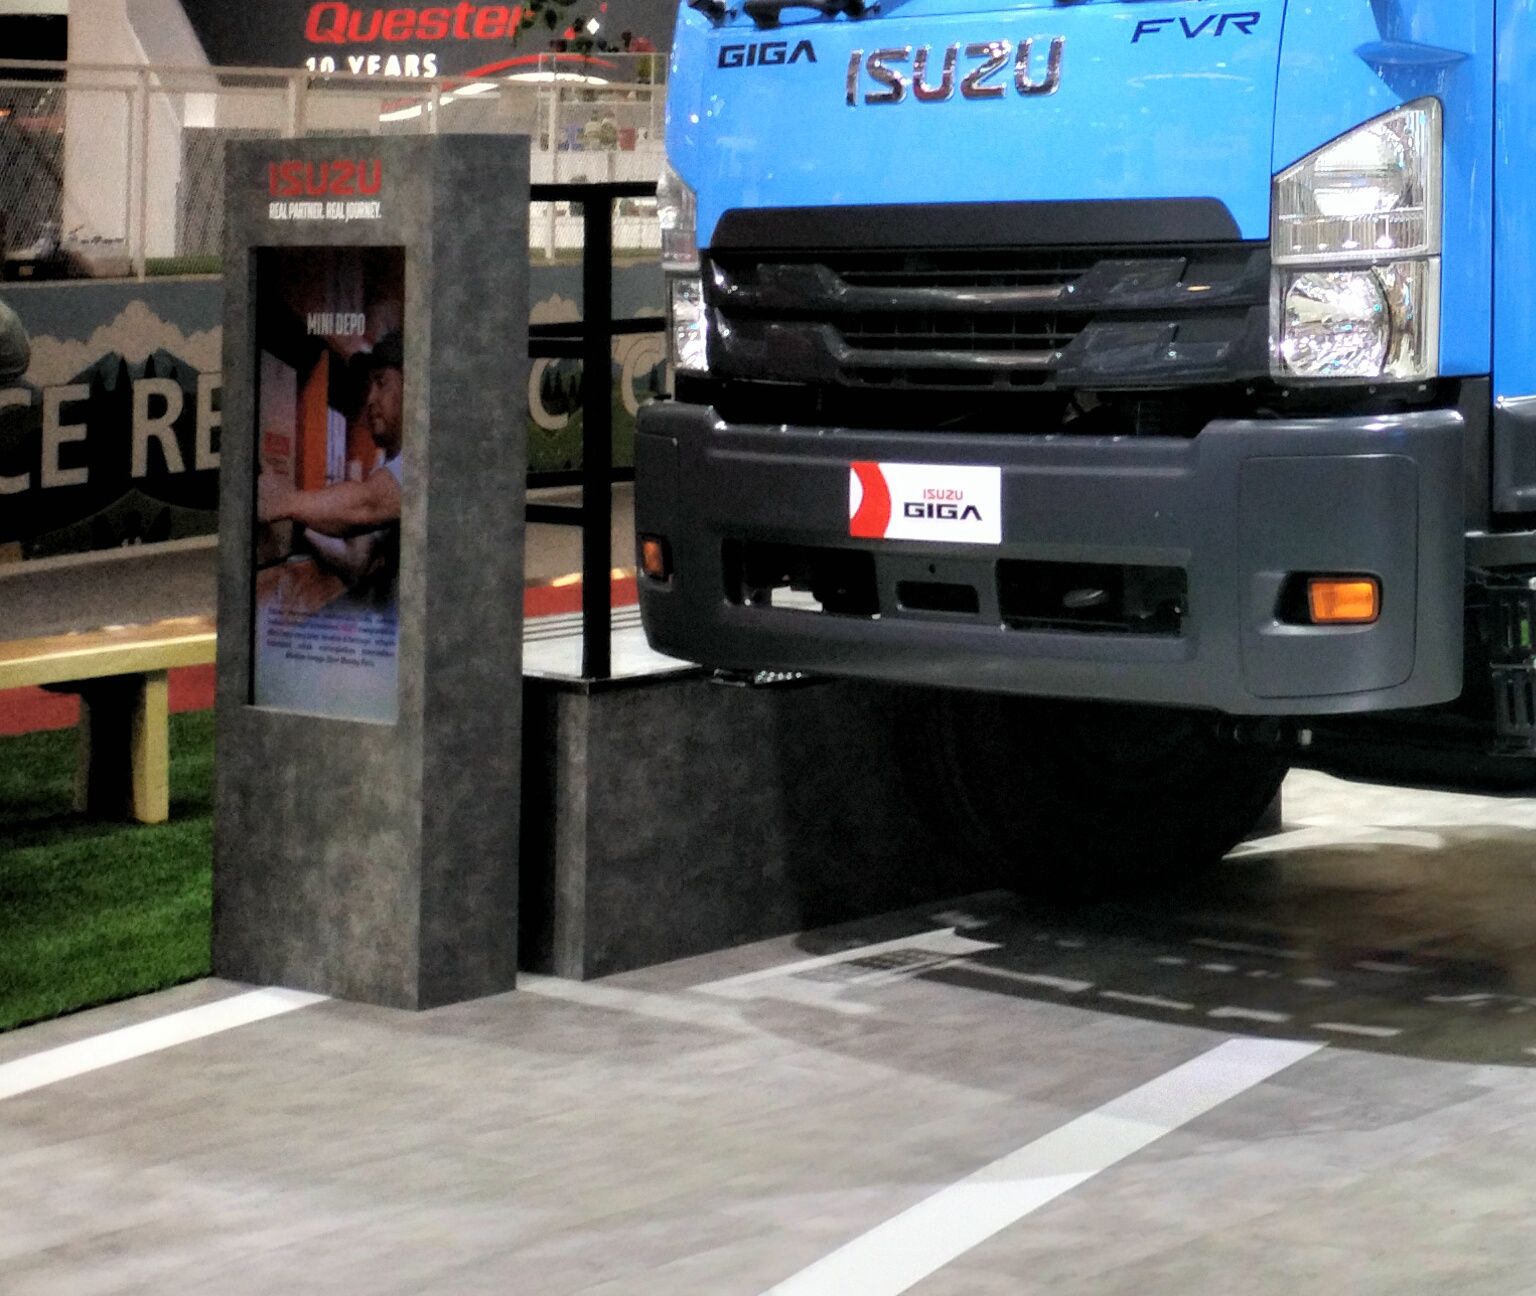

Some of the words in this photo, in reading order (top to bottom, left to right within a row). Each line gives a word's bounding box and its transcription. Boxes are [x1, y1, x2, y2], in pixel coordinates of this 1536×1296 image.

[304, 0, 534, 44] Quester
[1130, 11, 1261, 44] FVR
[306, 55, 334, 75] 10
[348, 53, 437, 78] YEARS
[717, 40, 818, 70] GIGA
[846, 35, 1066, 107] ISUZU
[269, 159, 382, 196] ISUZU
[269, 202, 288, 220] REAL
[326, 202, 345, 220] REAL
[335, 312, 366, 336] DEPO
[923, 488, 964, 501] ISUZU
[904, 502, 983, 521] GIGA
